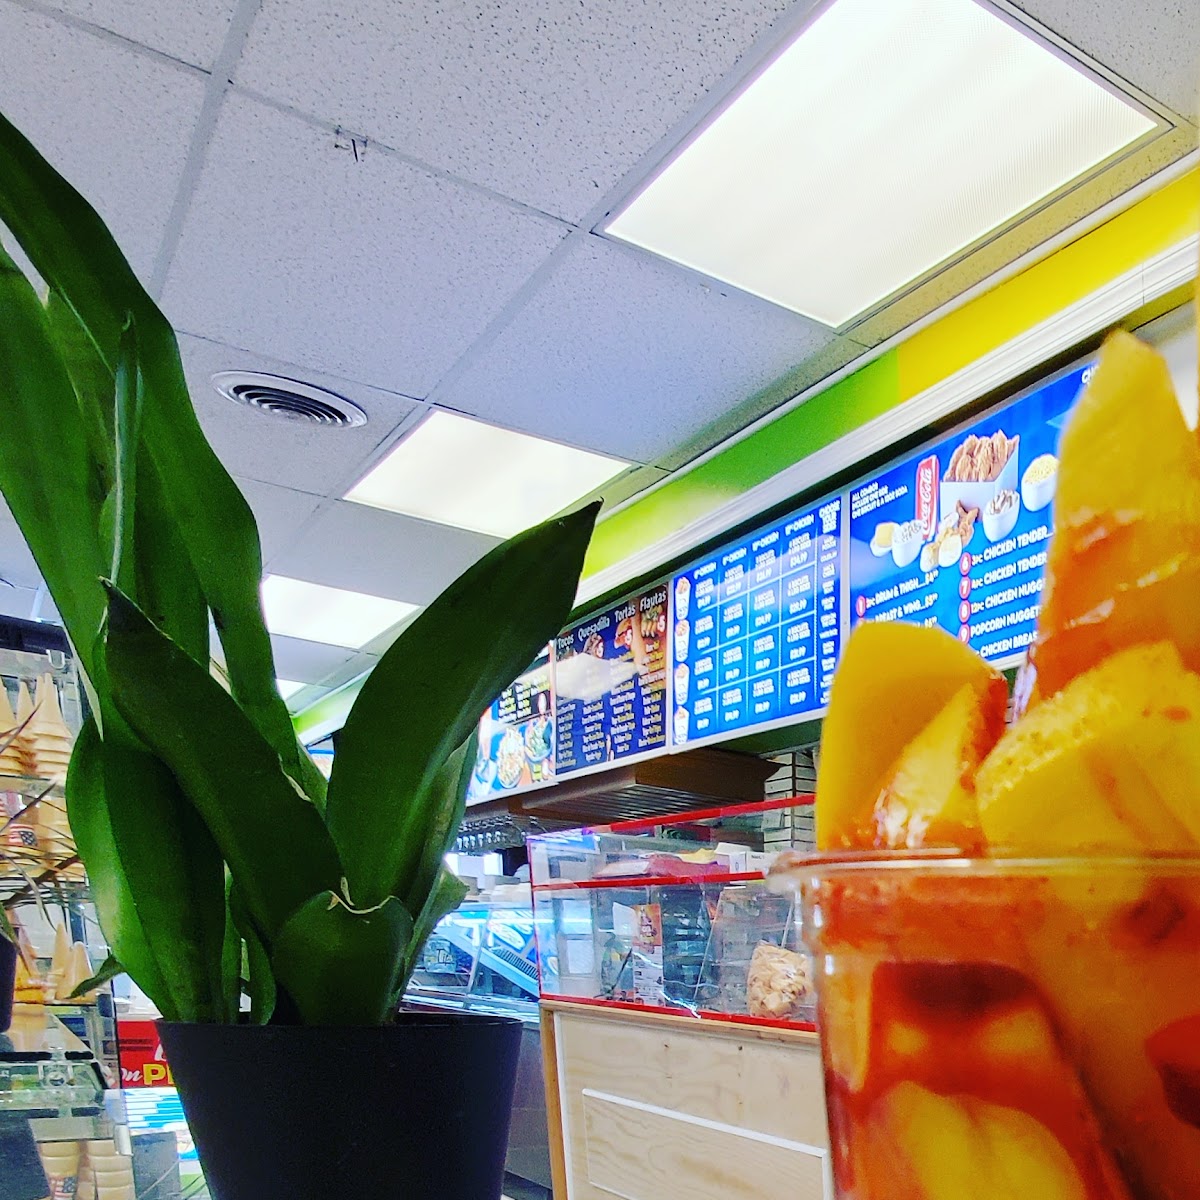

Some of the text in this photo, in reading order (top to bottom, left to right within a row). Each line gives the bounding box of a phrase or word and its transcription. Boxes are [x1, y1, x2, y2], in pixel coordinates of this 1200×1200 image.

[983, 538, 1017, 561] CHICKEN
[983, 562, 1017, 585] CHICKEN
[640, 590, 667, 612] Flautas
[875, 587, 893, 605] DRUM
[985, 586, 1018, 609] CHICKEN
[1018, 577, 1046, 598] NUGG
[614, 605, 636, 623] Tortas
[970, 616, 1006, 638] POPCORN
[980, 630, 1038, 658] CHICKEN BREAS
